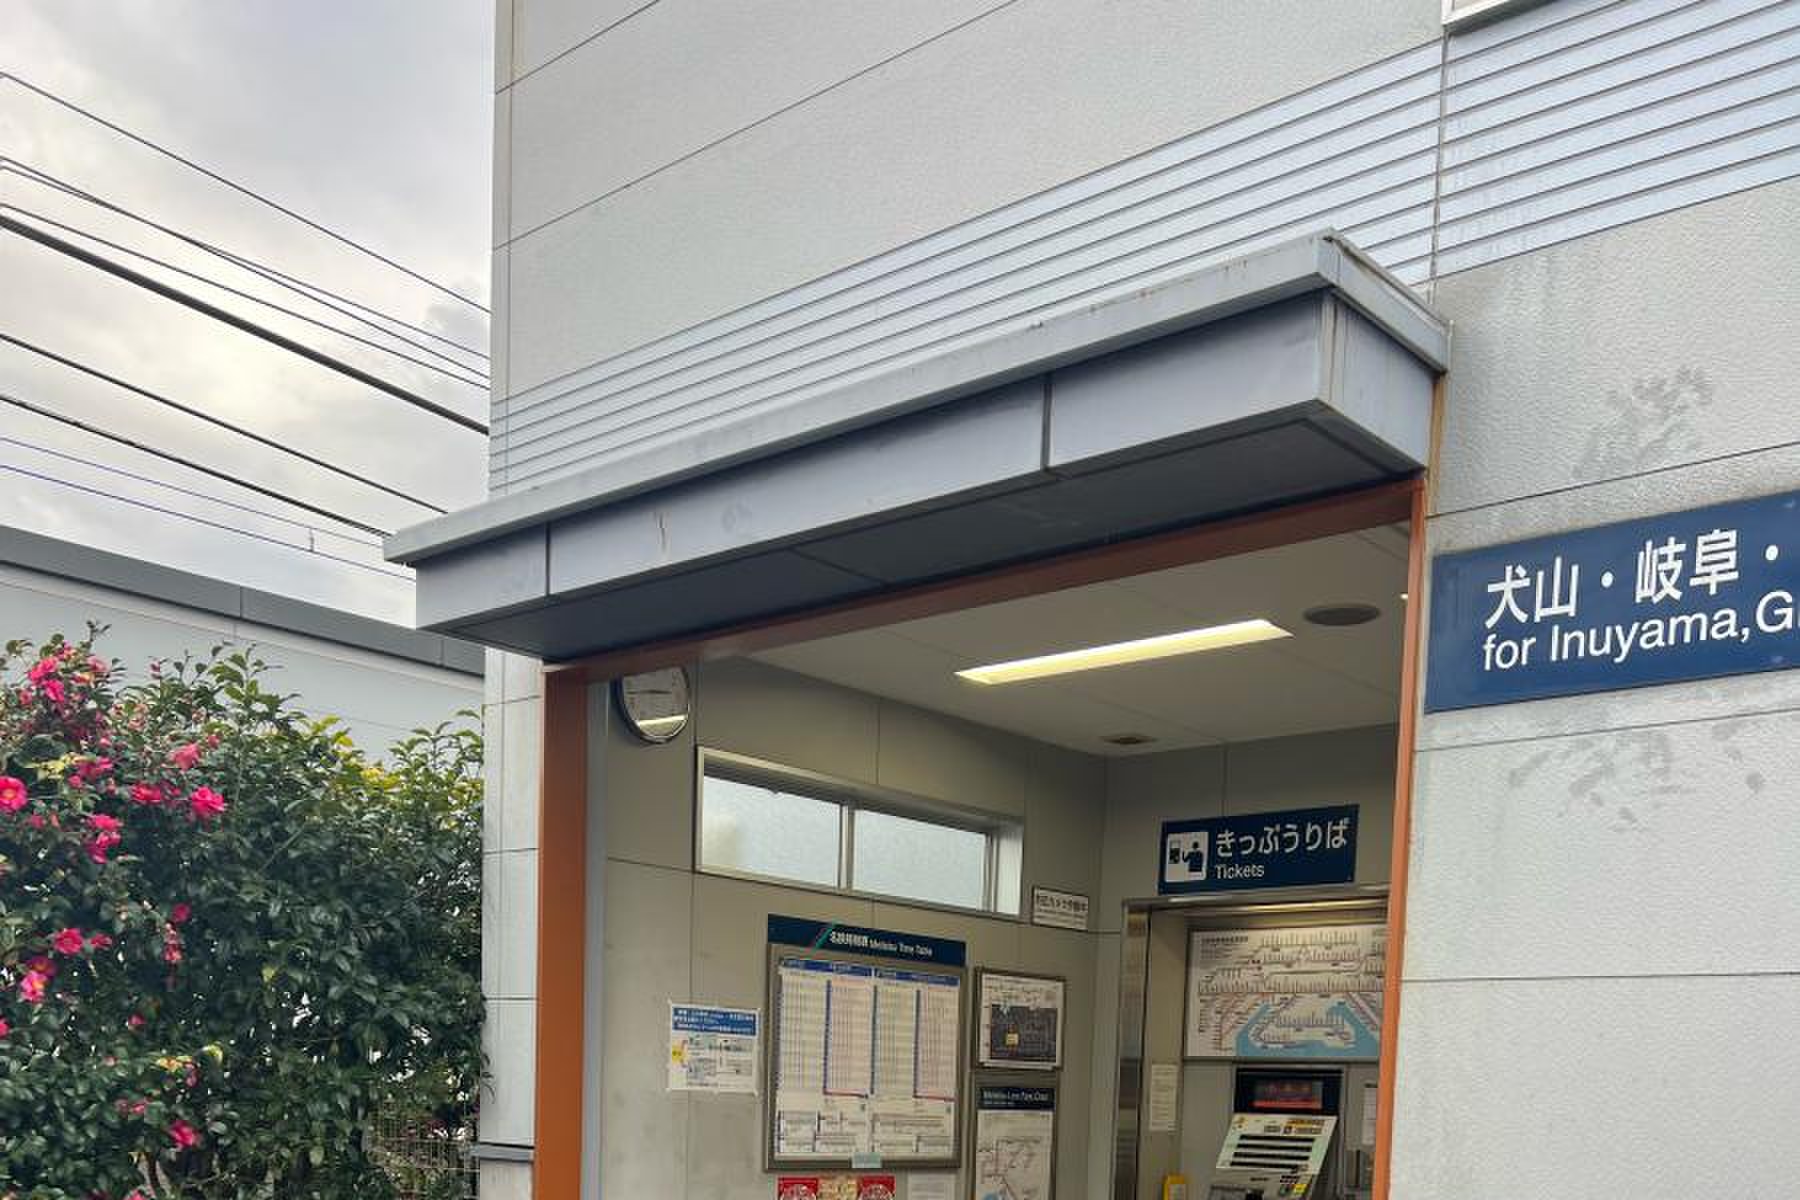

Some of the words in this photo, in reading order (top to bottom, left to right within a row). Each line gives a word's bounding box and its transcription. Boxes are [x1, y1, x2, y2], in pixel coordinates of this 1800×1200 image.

[1484, 528, 1779, 630] 犬山・岐阜・
[1482, 634, 1537, 671] for
[1550, 590, 1800, 663] Inuyama,G
[1215, 817, 1350, 858] きっぷうりば
[1215, 863, 1265, 880] Tickets
